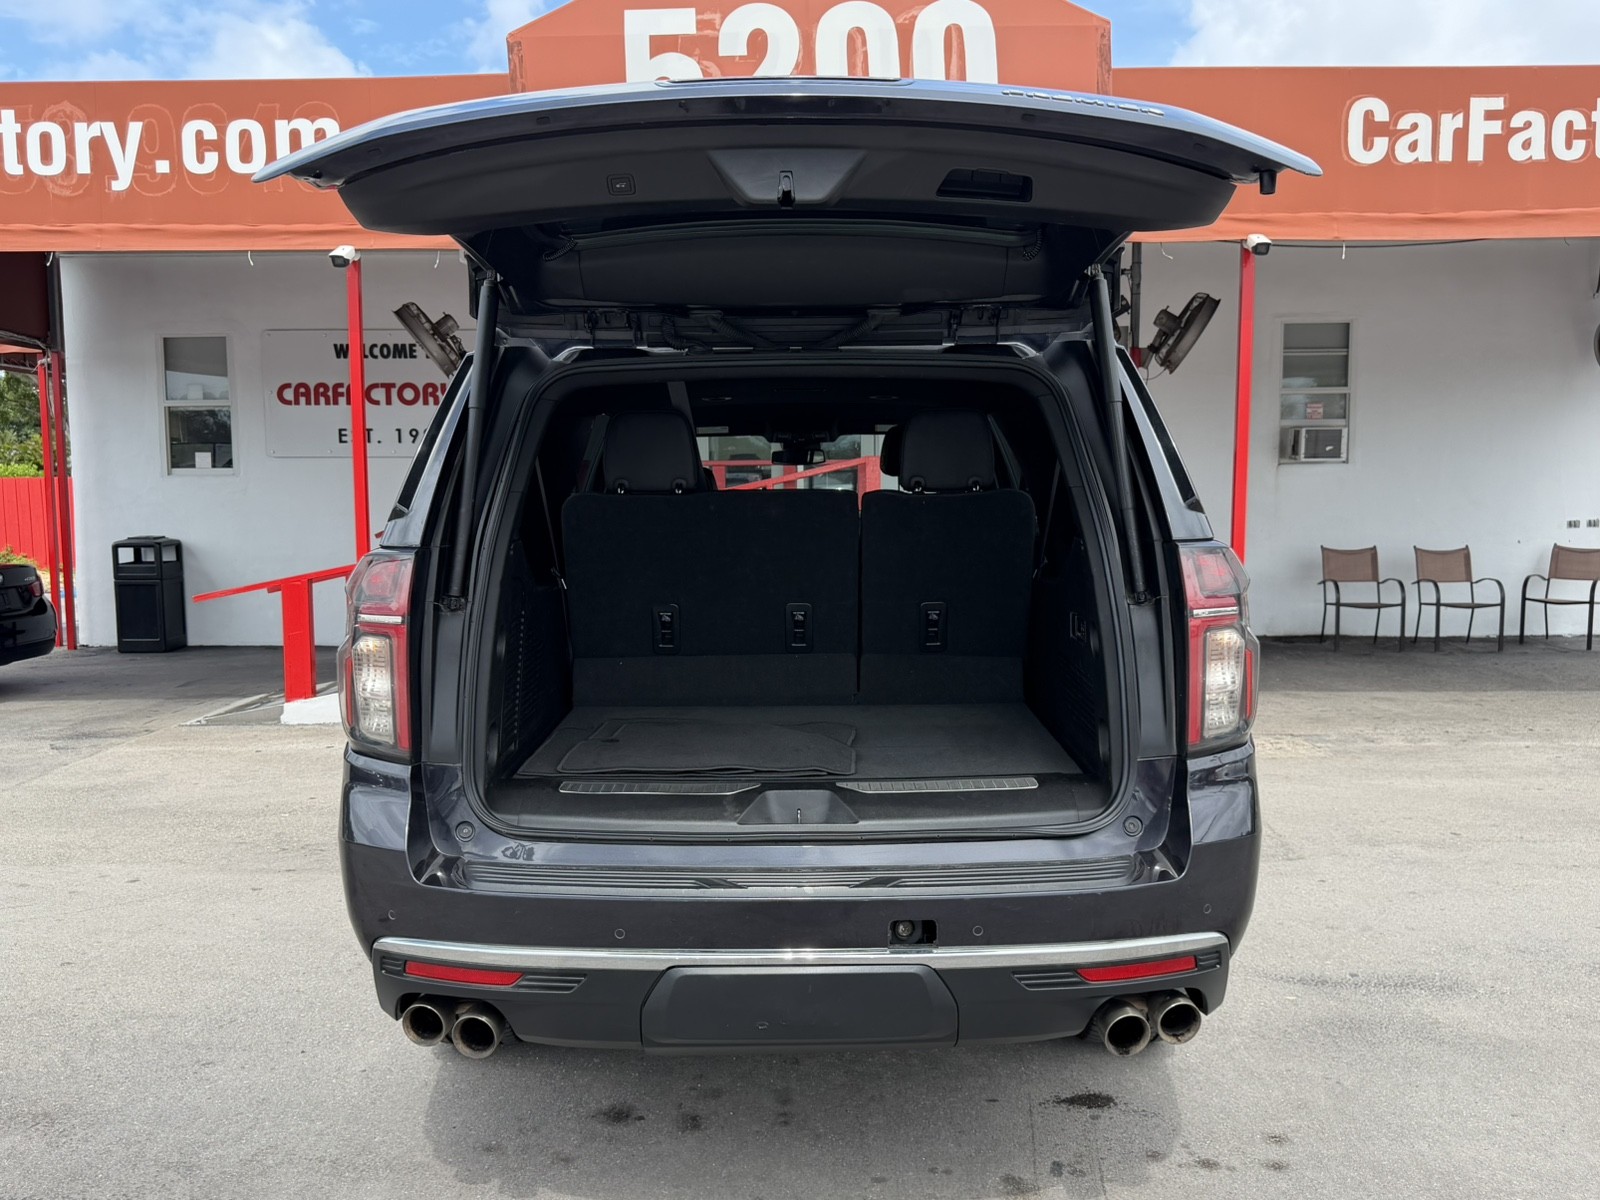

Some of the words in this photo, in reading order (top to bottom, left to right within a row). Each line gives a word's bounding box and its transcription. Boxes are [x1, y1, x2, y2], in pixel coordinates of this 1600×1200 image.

[333, 343, 417, 359] WLCOME
[276, 382, 447, 406] CARFCTOR
[338, 428, 382, 444] ET.
[395, 428, 428, 444] 19
